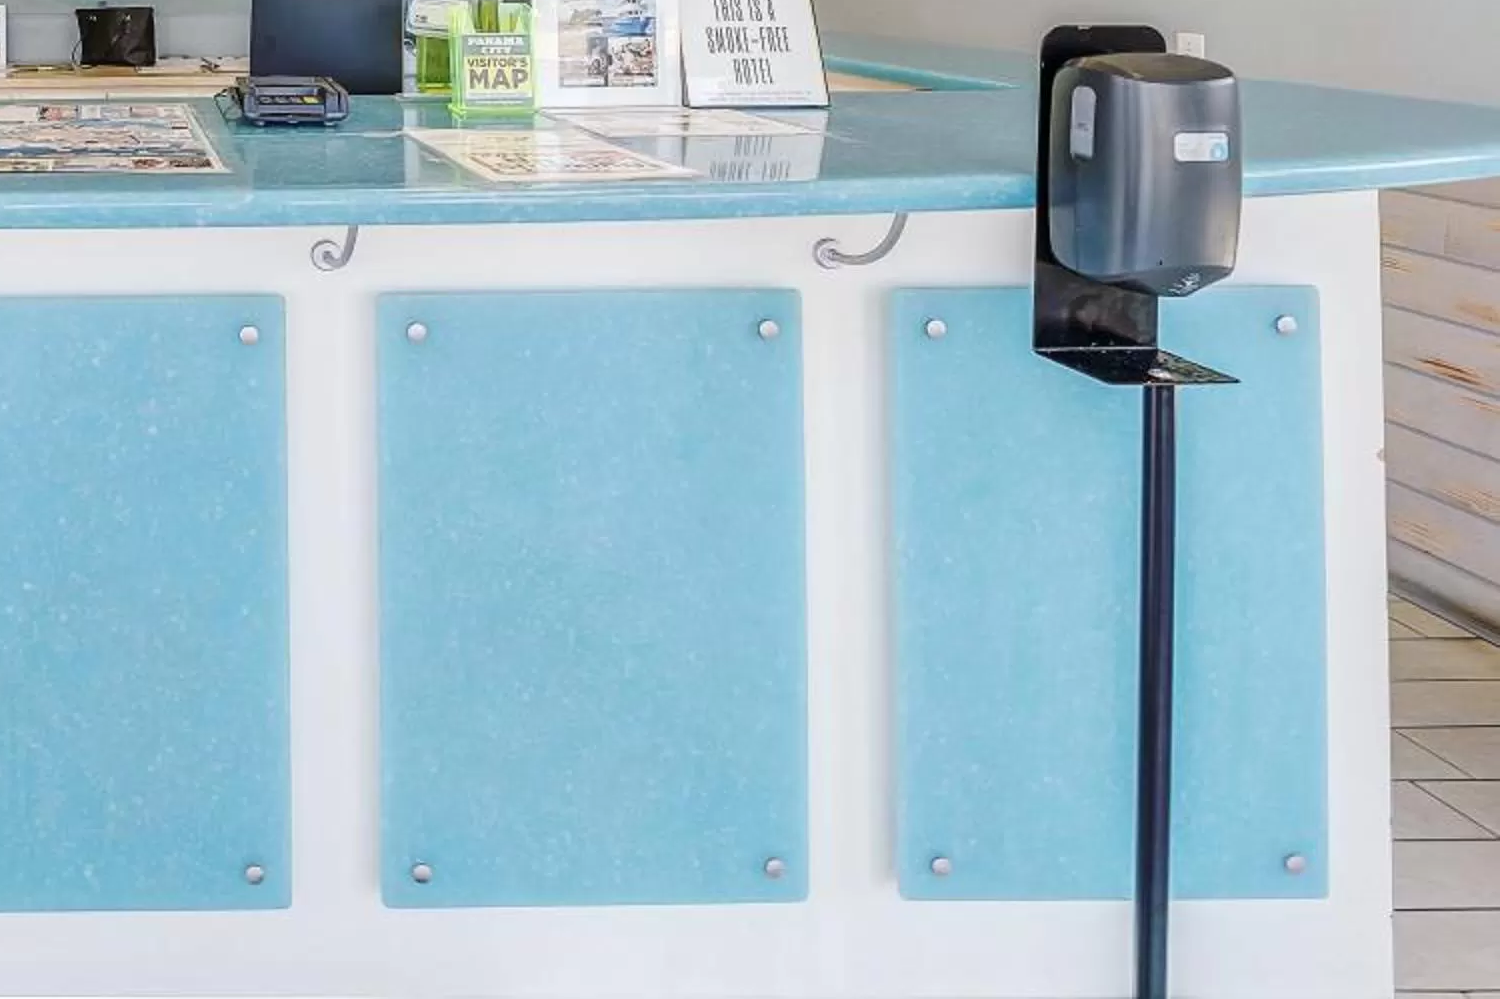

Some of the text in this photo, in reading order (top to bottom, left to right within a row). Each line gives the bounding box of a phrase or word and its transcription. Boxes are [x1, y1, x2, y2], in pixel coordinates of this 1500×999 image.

[467, 36, 524, 46] PANAMA
[705, 26, 792, 54] SMOKE-FREE
[467, 56, 529, 68] VISITOR'S
[733, 57, 775, 85] HOTEL
[469, 68, 530, 90] MAP
